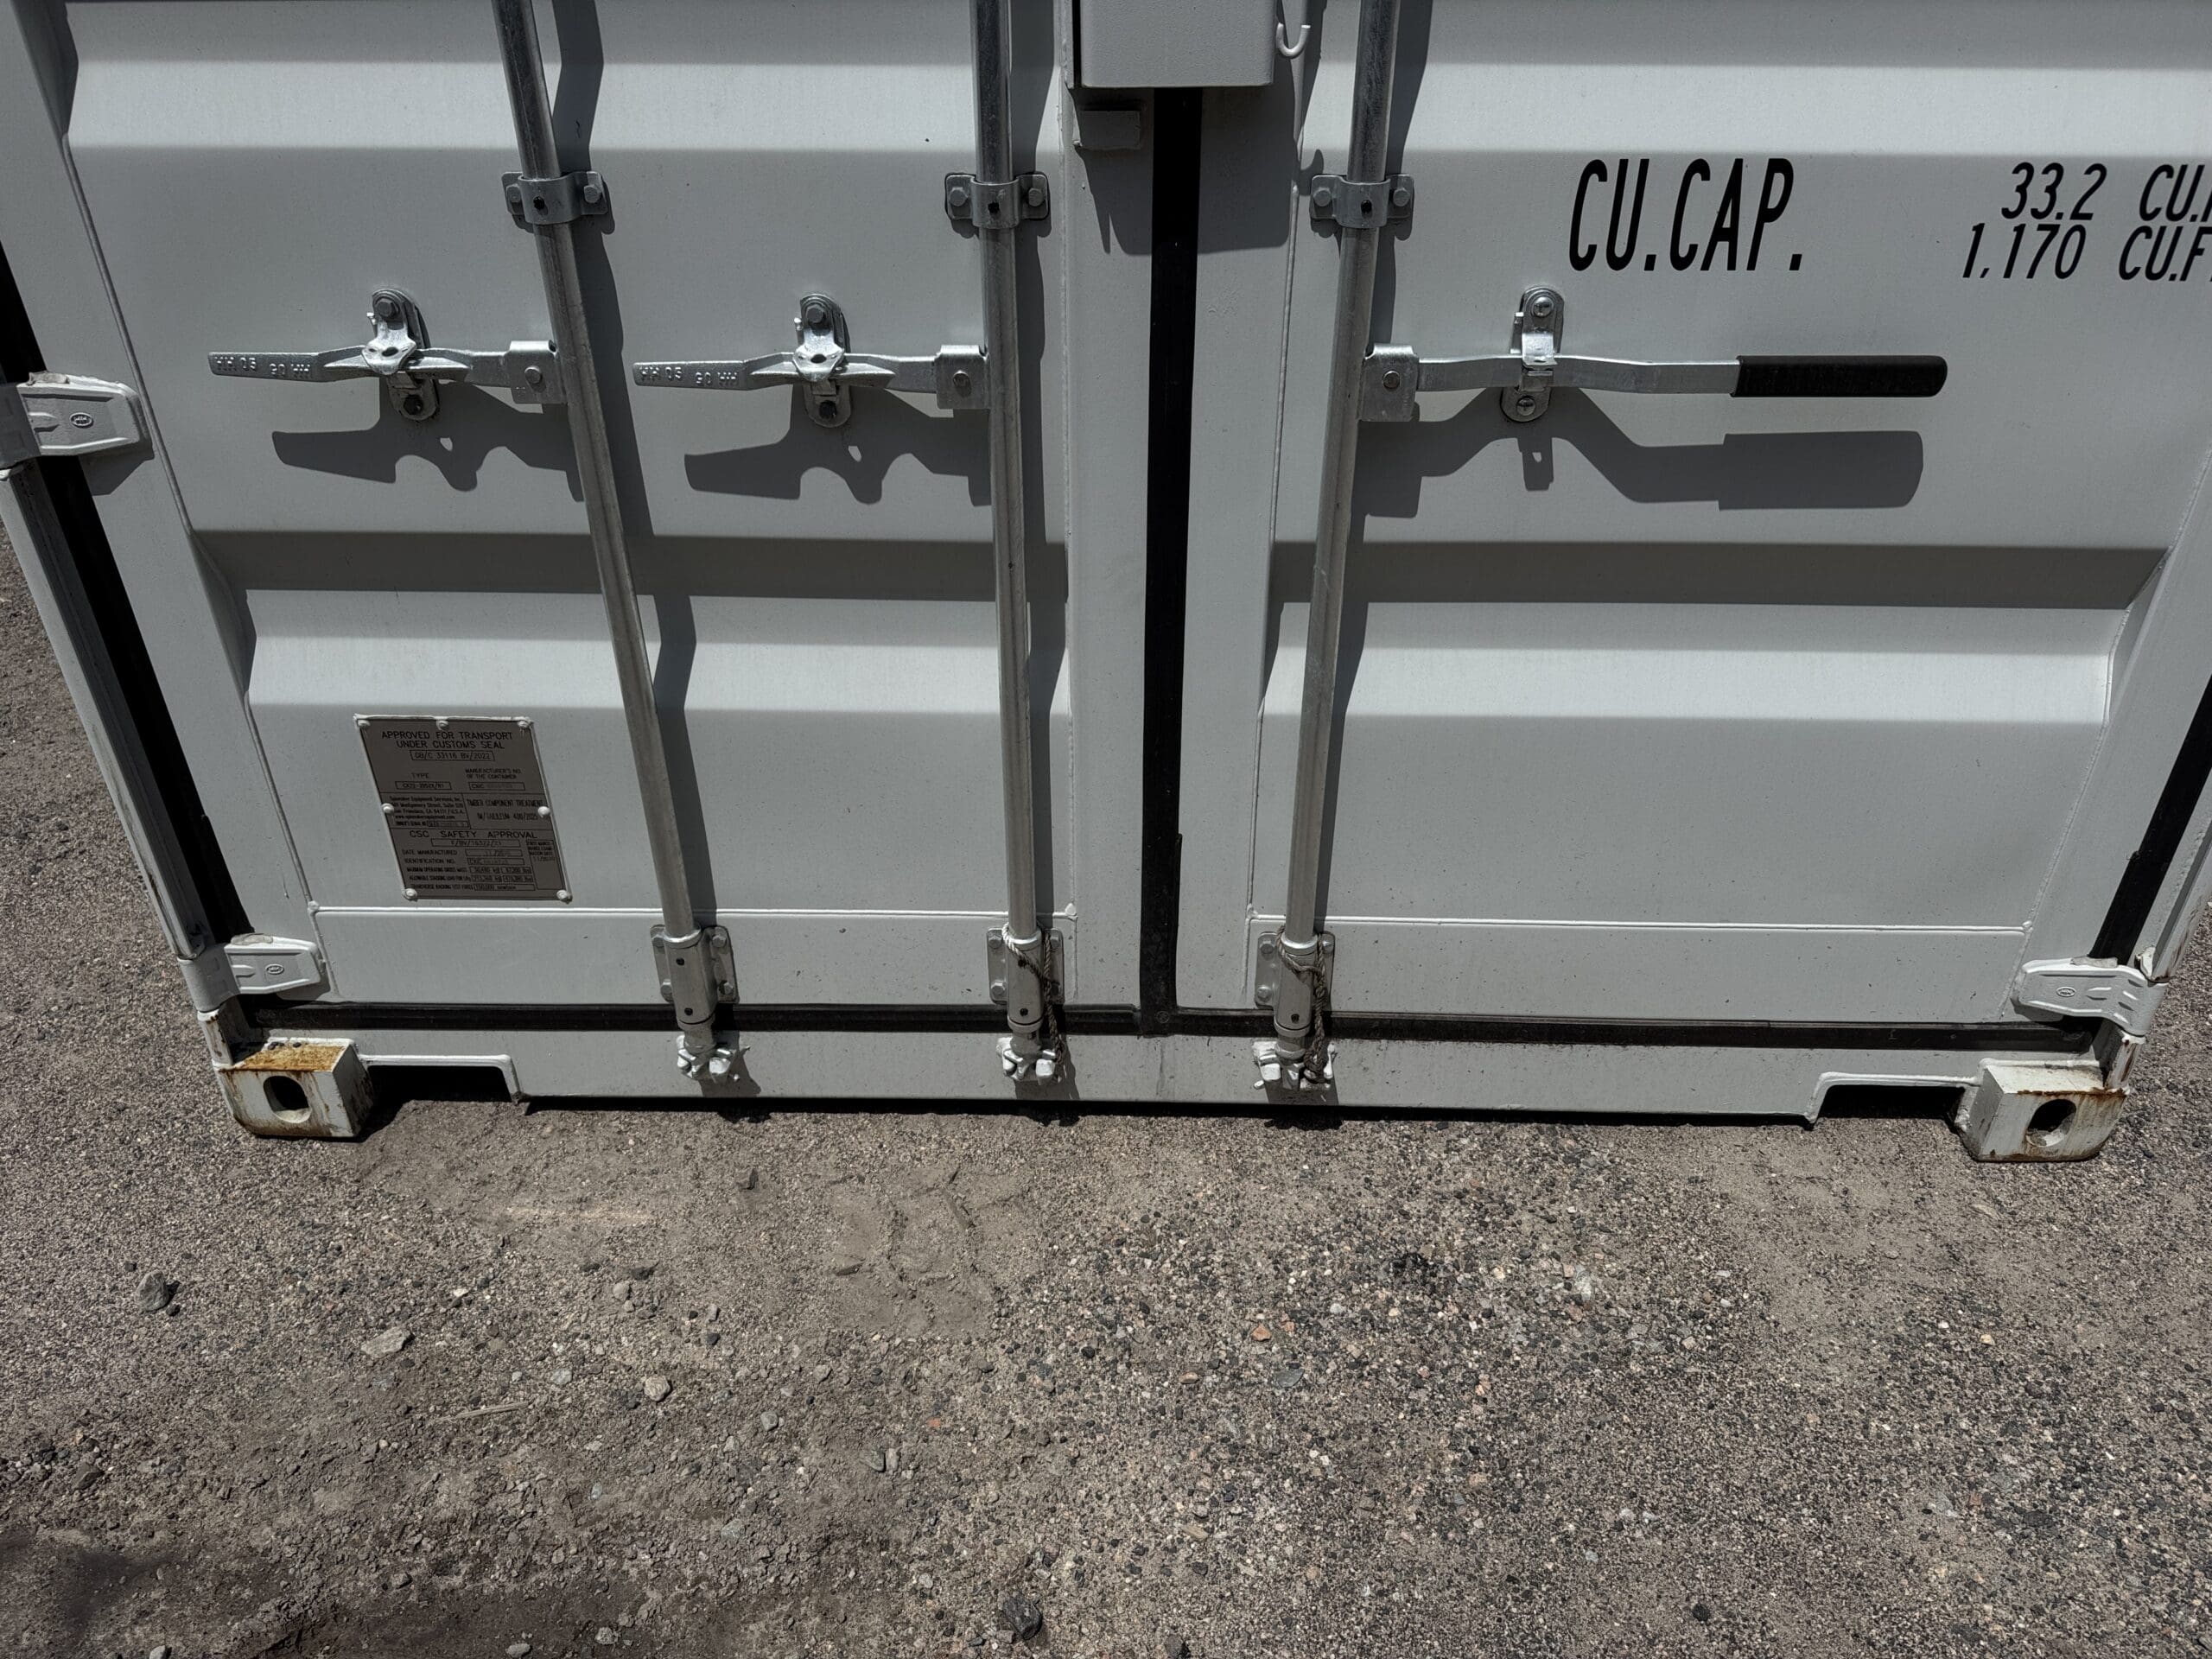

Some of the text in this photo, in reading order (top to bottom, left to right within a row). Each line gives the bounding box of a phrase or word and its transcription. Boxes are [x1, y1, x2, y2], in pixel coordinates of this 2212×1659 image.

[2000, 162, 2108, 221] 33.2
[1569, 157, 1803, 272] CU.CAP.
[1961, 221, 2212, 282] 1,170 CU.F
[381, 731, 513, 741] APPROVED FOR TRANSPORT
[396, 740, 505, 750] UNDER CUSTOMS SEAL
[487, 830, 537, 839] APPROVAL
